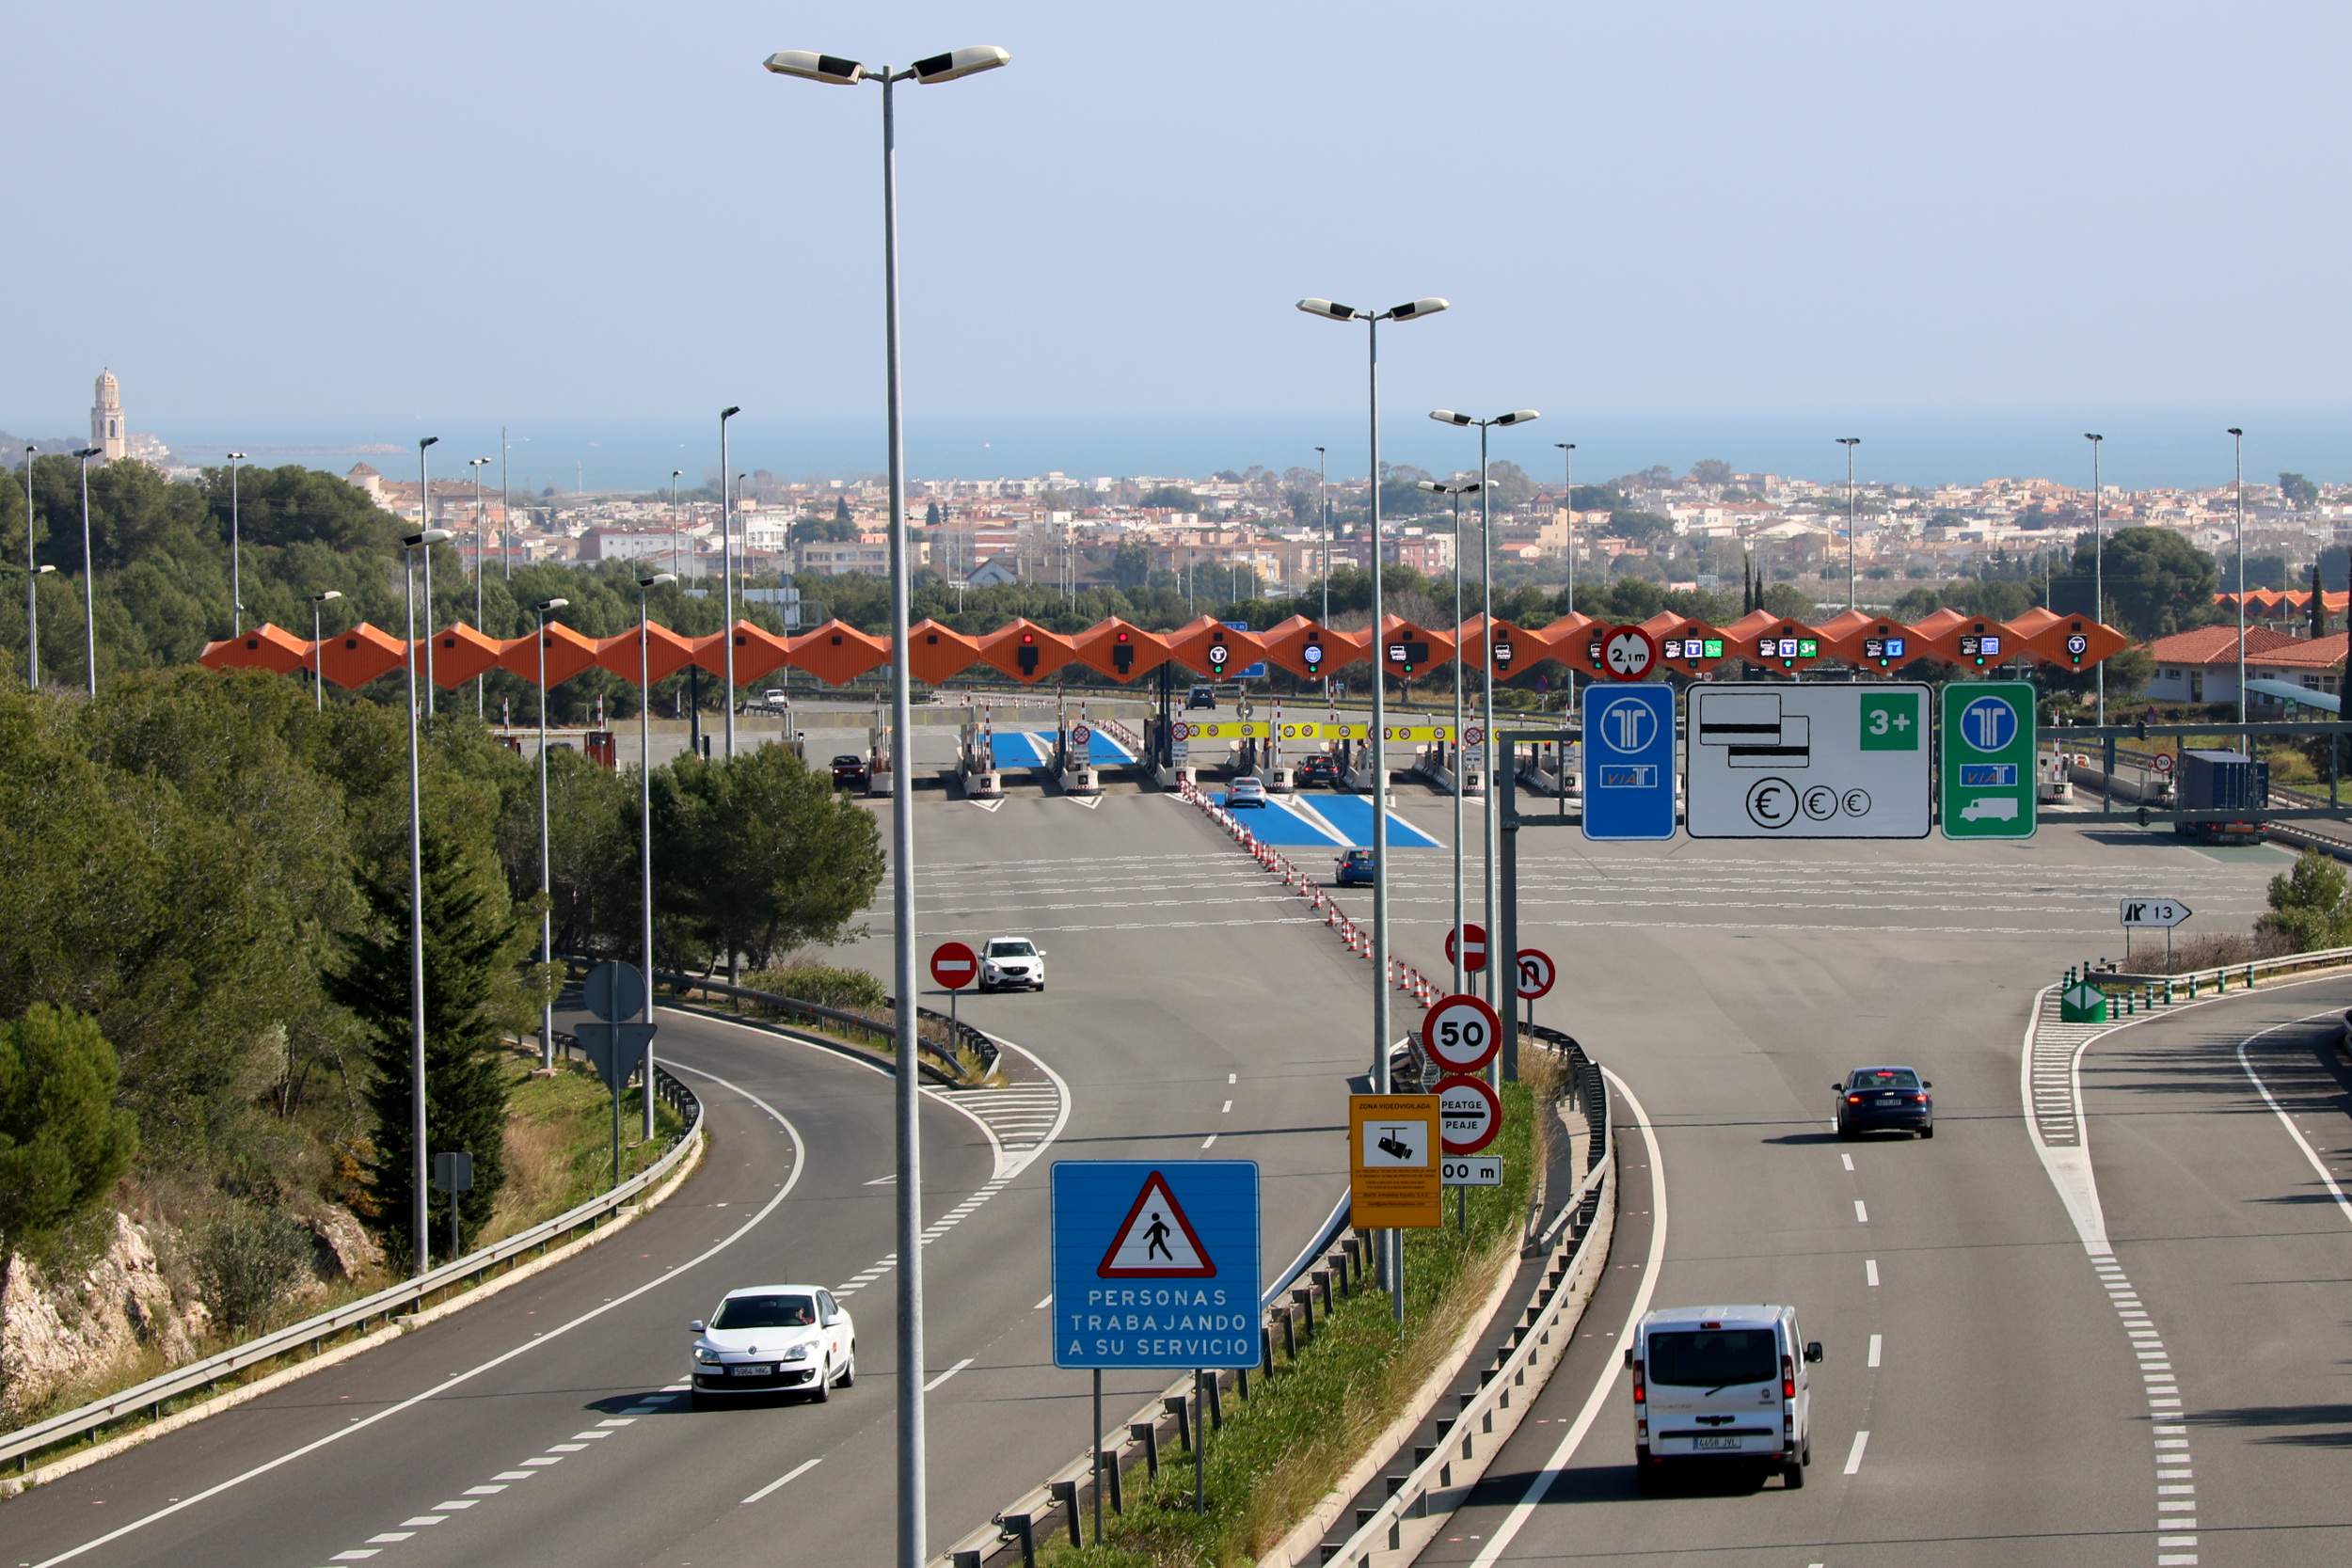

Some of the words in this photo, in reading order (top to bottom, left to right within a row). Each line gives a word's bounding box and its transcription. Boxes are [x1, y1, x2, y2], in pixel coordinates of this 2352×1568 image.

[1868, 709, 1911, 736] 3+
[2154, 906, 2173, 919] 13
[1440, 1022, 1484, 1046] 50
[1441, 1101, 1482, 1109] PEATGE
[1446, 1120, 1478, 1130] PEAJE
[1442, 1164, 1469, 1179] 00
[1480, 1167, 1494, 1178] m
[1089, 1290, 1226, 1306] PERSONAS
[1072, 1314, 1246, 1331] TRABAJANDO
[1069, 1339, 1083, 1354] A
[1096, 1338, 1124, 1354] SU
[1137, 1338, 1248, 1355] SERVICIO
